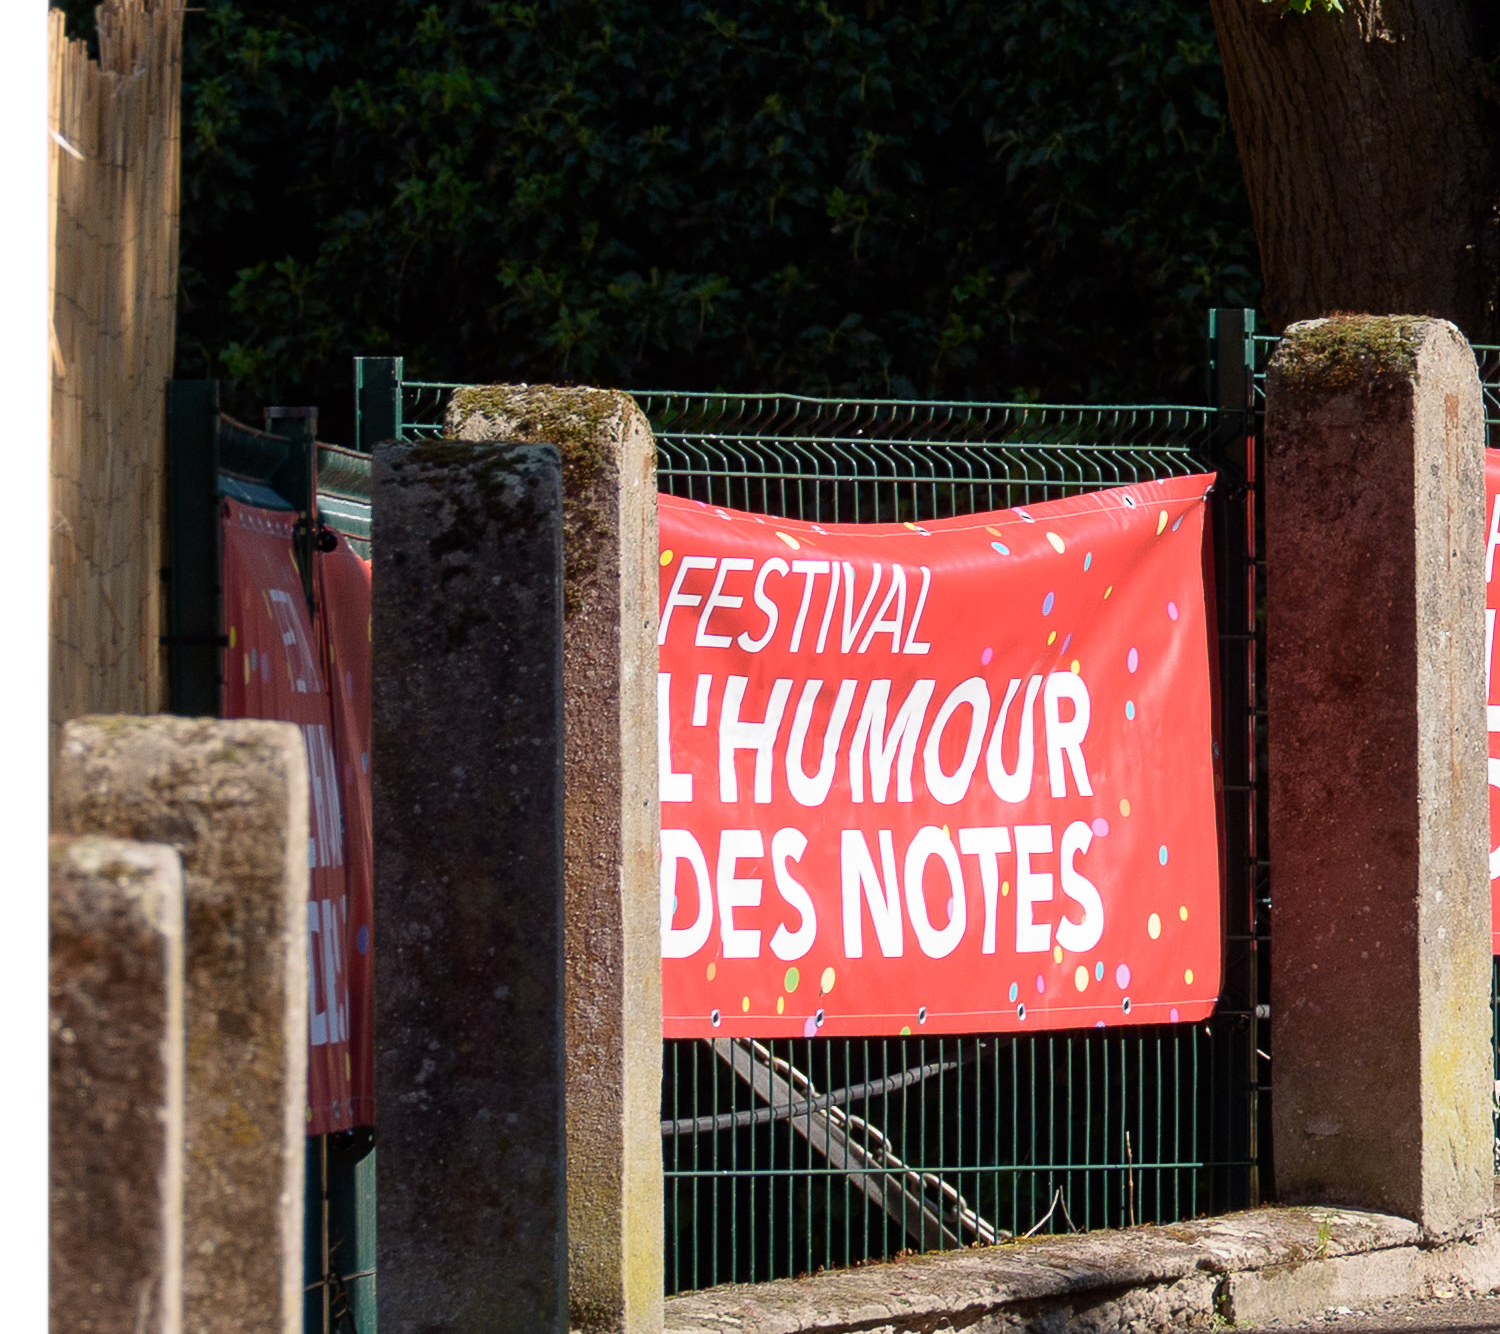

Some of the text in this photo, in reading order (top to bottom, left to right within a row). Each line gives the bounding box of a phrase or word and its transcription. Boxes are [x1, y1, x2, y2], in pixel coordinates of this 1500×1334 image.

[658, 555, 932, 655] FESTIVAL
[657, 670, 1094, 808] L'HUMOUR
[659, 820, 1104, 961] DES NOTES
